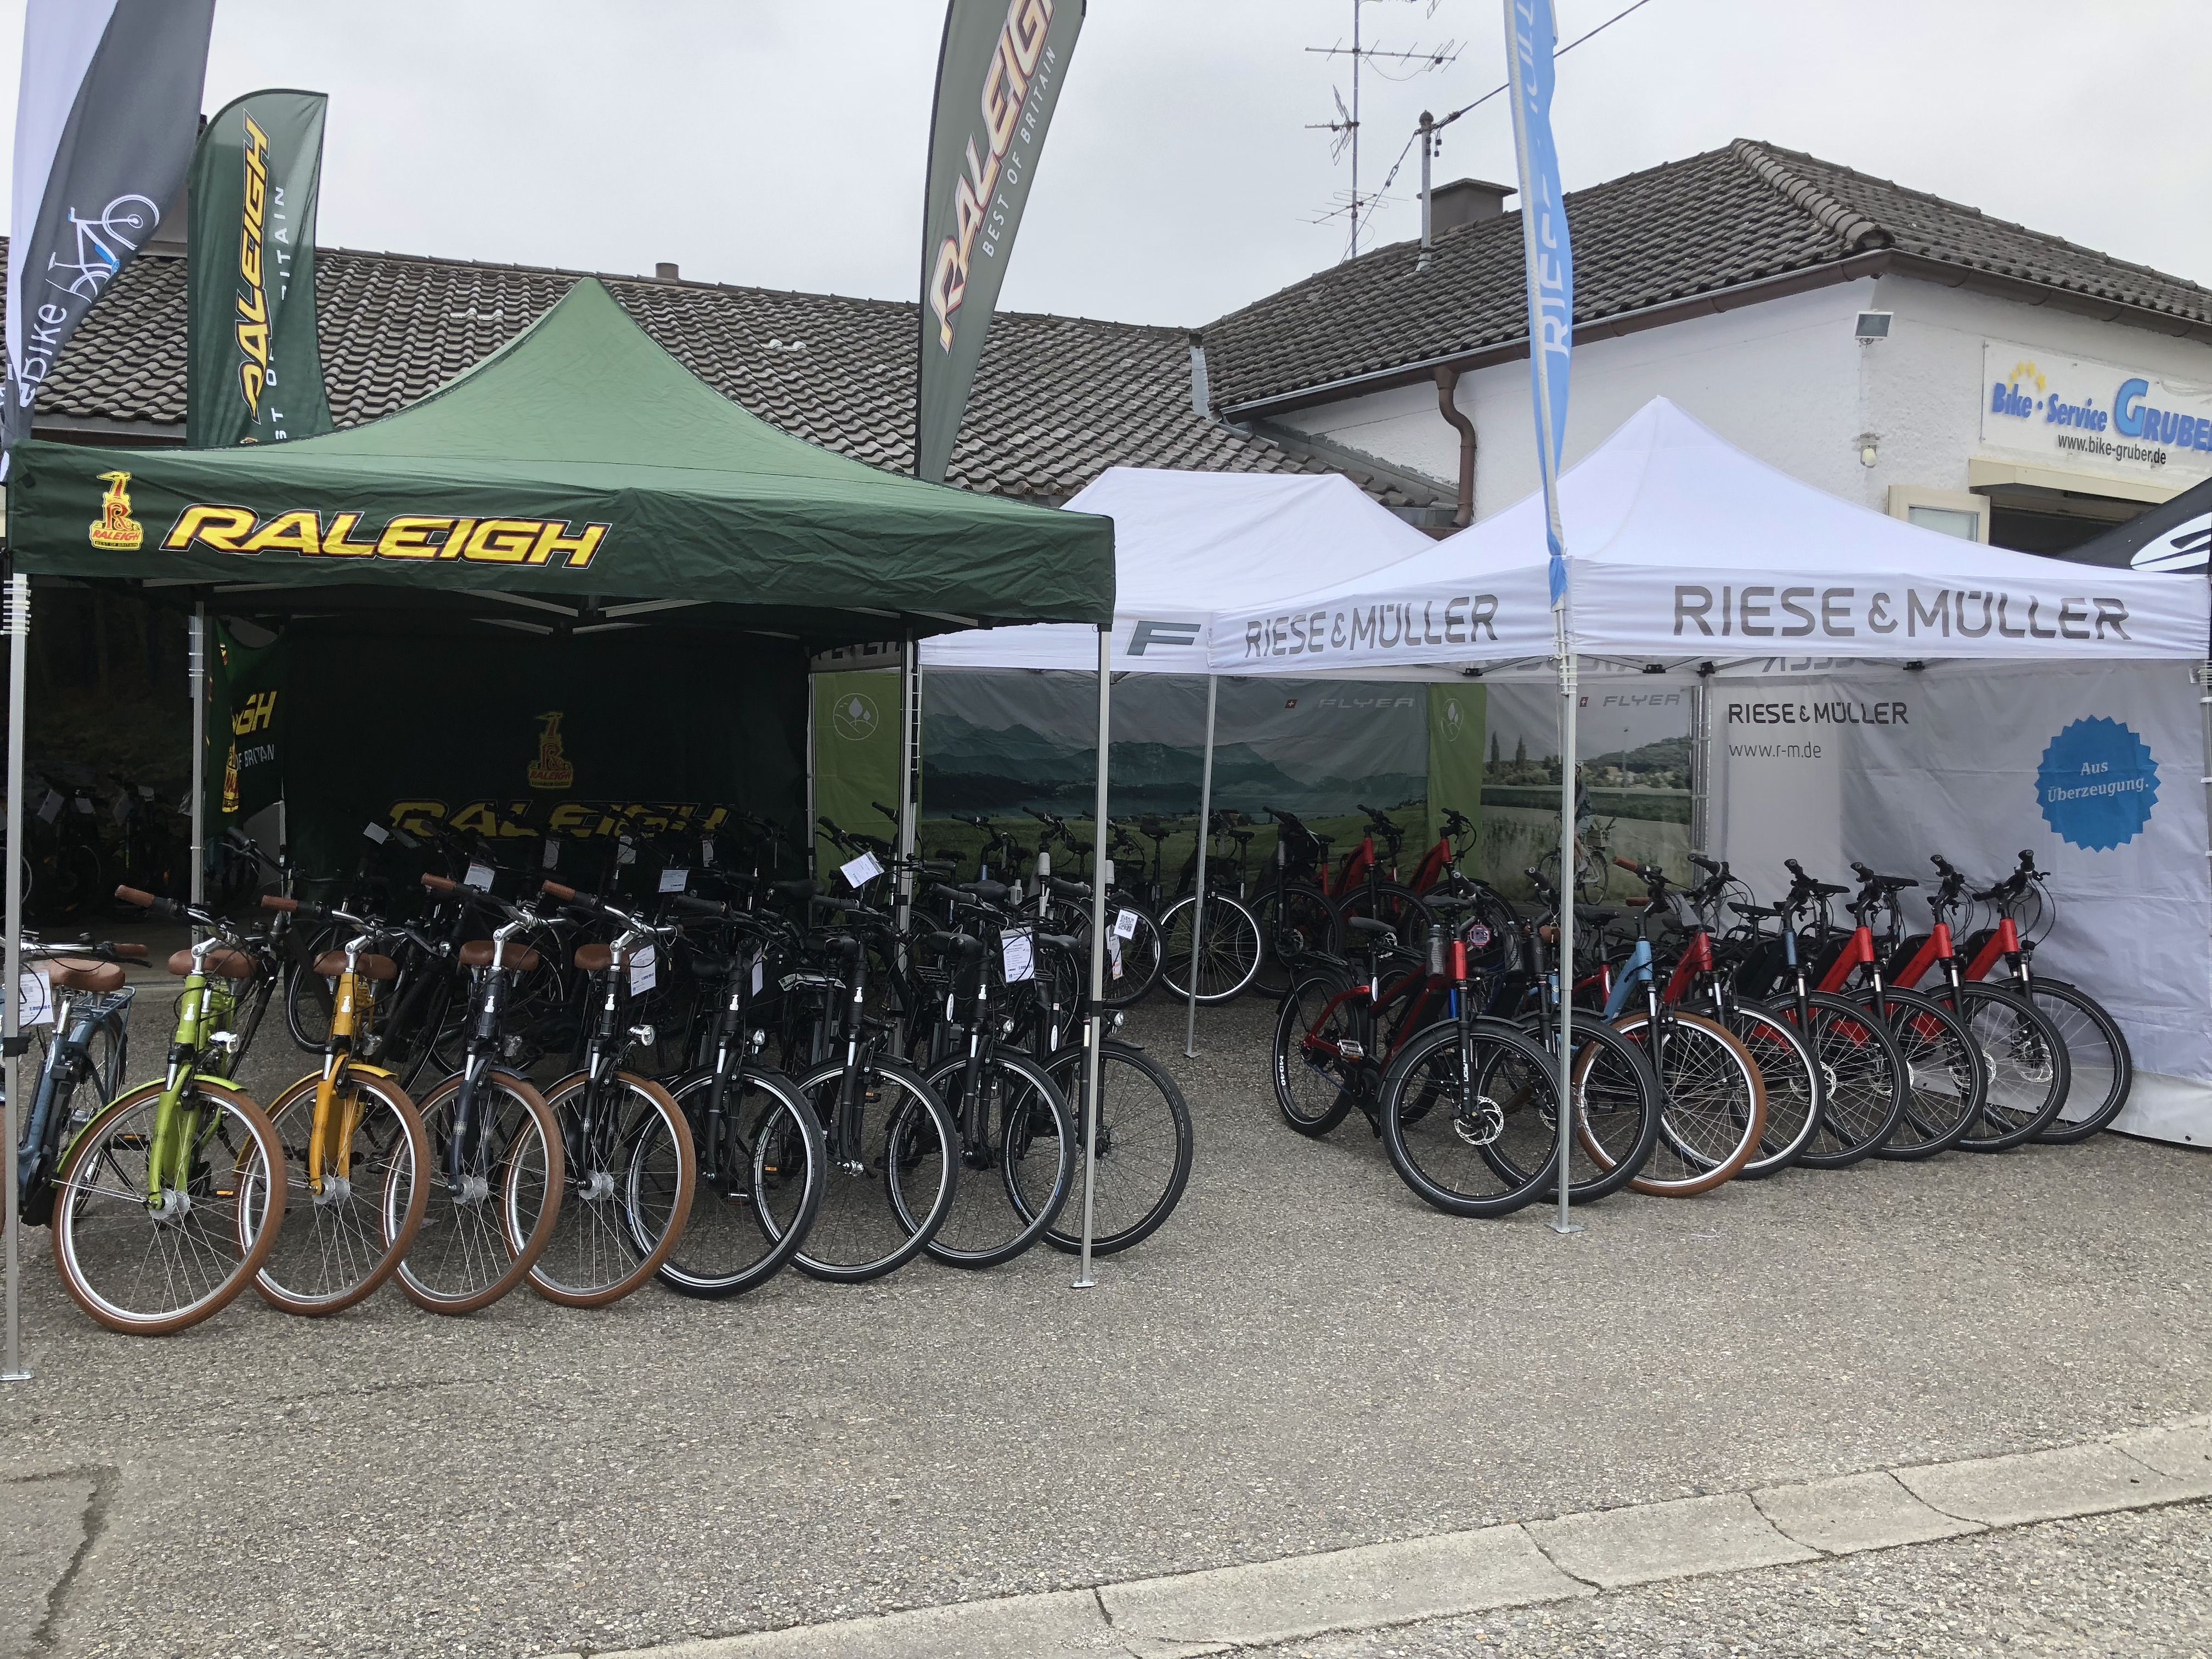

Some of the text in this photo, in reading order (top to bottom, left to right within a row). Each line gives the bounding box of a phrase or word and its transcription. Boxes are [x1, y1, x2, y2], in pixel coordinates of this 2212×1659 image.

[982, 46, 1056, 258] BEST OF BRITAIN
[930, 0, 1055, 359] RALEIG
[1992, 378, 2212, 452] Bike Service GRUBE
[2058, 434, 2166, 465] www.bike-gruber.de
[92, 529, 141, 541] RALEIGH
[159, 503, 612, 569] RALEIGH
[1318, 697, 1415, 709] FLYER
[1602, 694, 1680, 707] FLYER
[1729, 742, 1821, 758] www.r-m.de
[2080, 761, 2108, 776] Aus
[2047, 776, 2149, 803] Überzeugung.
